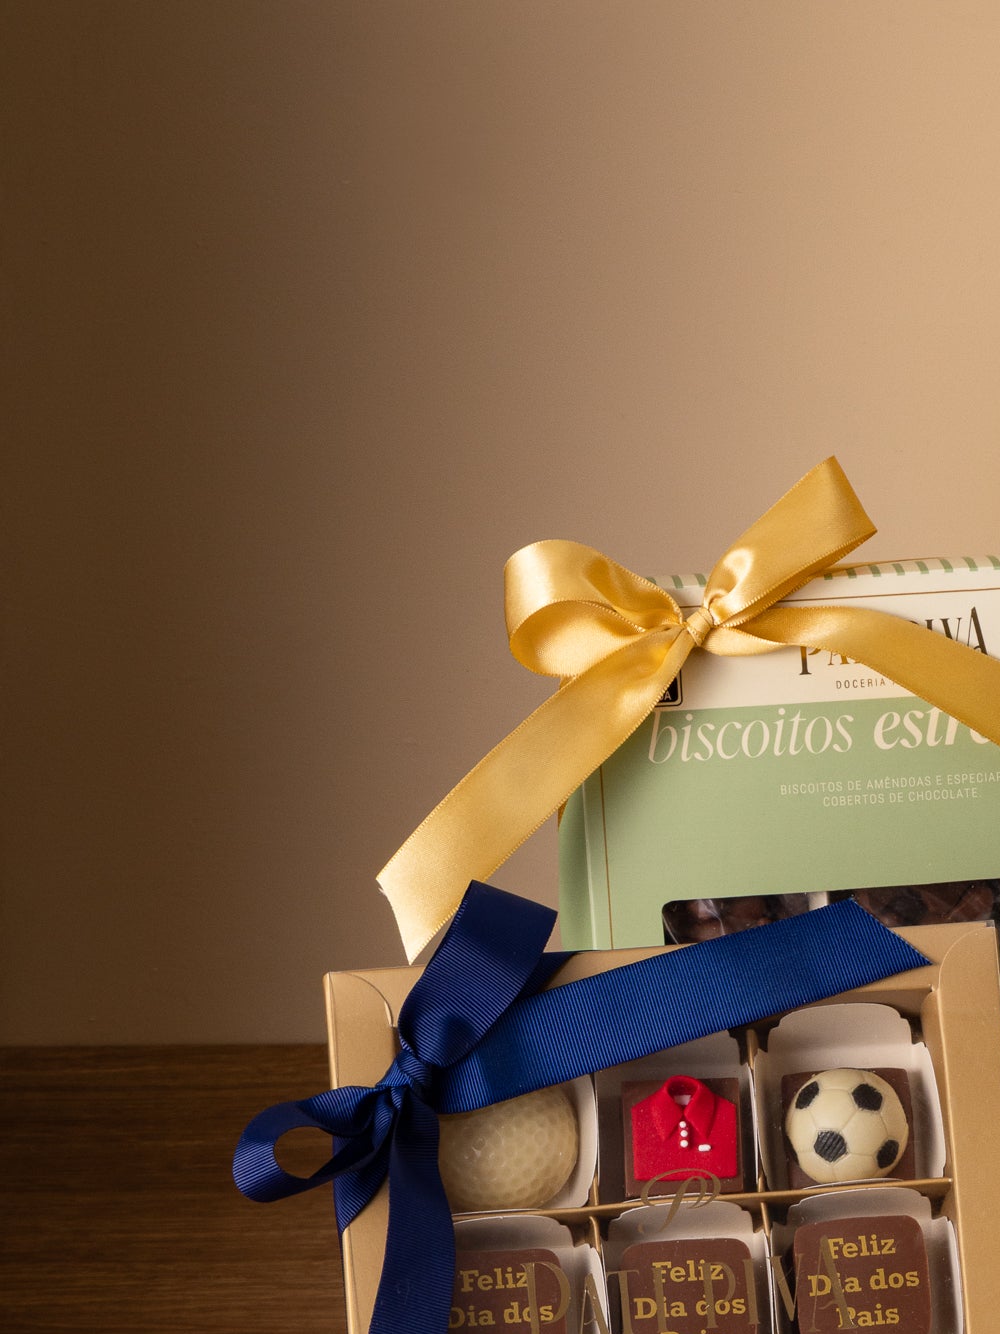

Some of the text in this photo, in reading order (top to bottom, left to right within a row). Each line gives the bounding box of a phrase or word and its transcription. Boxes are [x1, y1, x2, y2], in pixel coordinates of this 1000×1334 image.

[836, 678, 886, 690] DOCERIA
[648, 707, 854, 764] biscoitos
[780, 781, 843, 795] BISCOITOS
[848, 780, 862, 791] DE
[866, 775, 931, 790] AMÊNDOAS
[936, 775, 943, 786] E
[823, 793, 885, 807] COBERTOS
[889, 792, 904, 803] DE
[827, 1234, 896, 1260] Feliz
[459, 1267, 529, 1292] Feliz
[652, 1259, 724, 1284] Feliz
[869, 1268, 920, 1290] dos
[702, 1234, 858, 1334] PIVA
[448, 1305, 496, 1329] Dia
